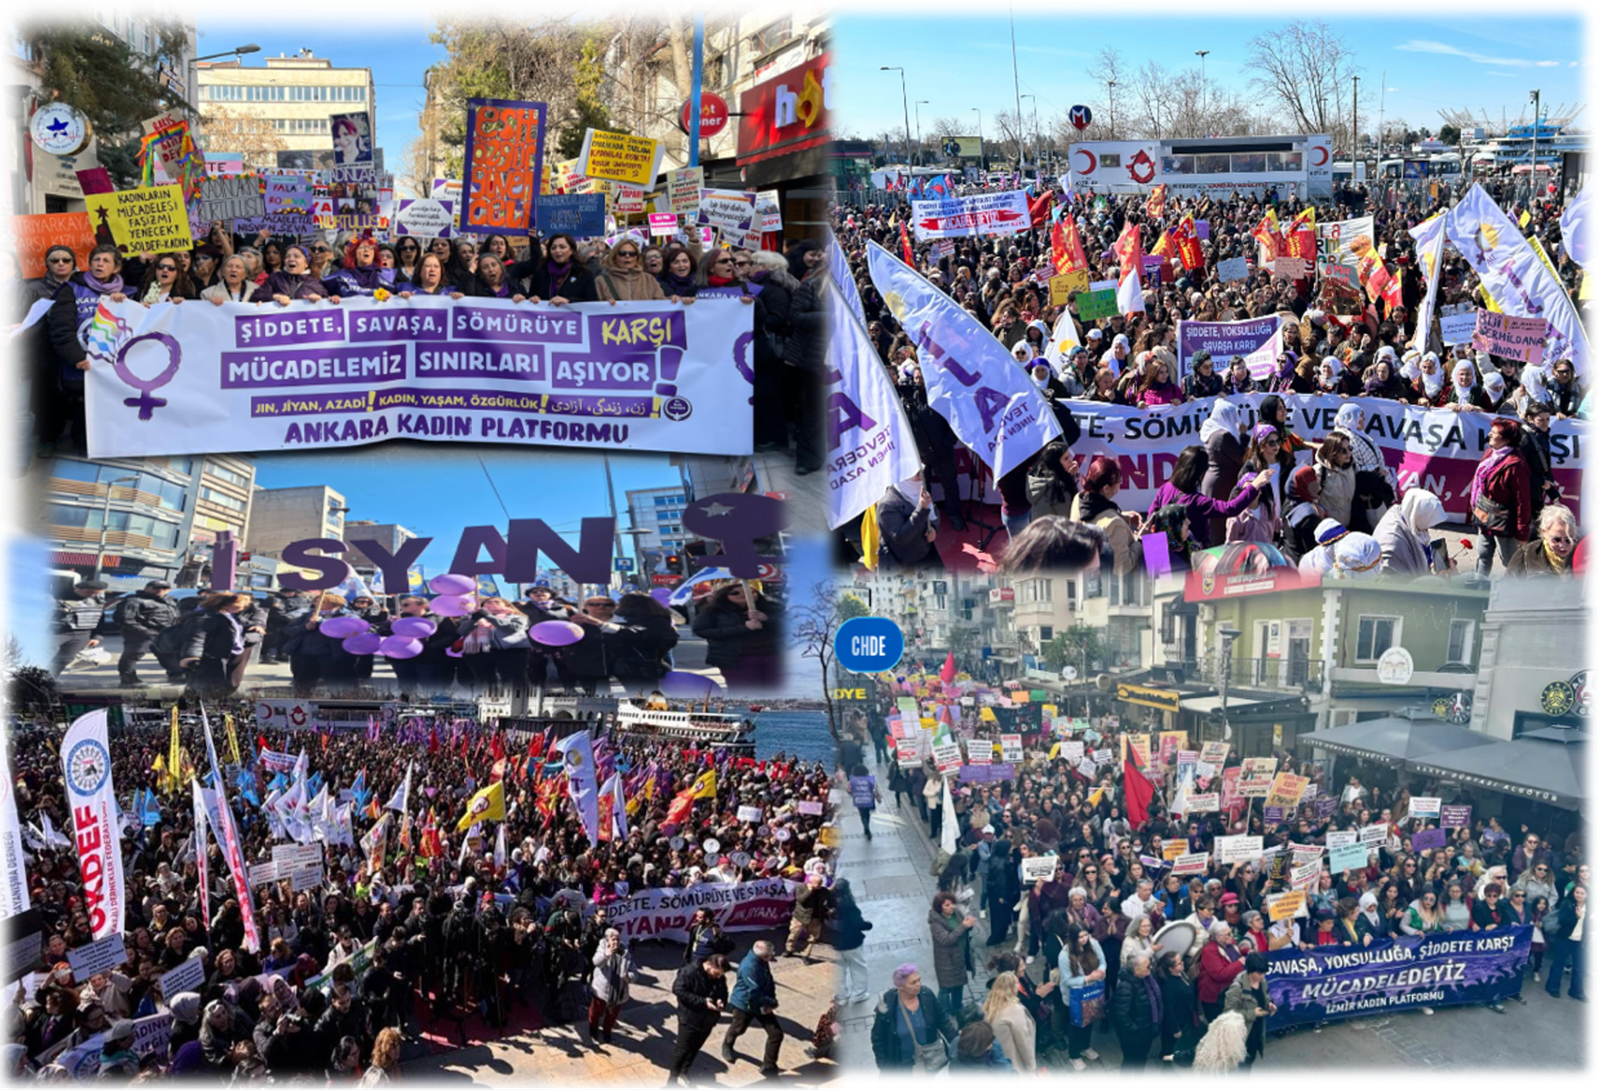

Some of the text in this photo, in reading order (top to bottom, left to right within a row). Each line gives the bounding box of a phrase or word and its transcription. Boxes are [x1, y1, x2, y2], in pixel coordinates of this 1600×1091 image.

[241, 311, 672, 347] ŞİDDETE, SAVAŞA, SÖMÜRÜYE KARŞI
[1186, 321, 1273, 341] ŞİDDETE, YOKSULLUĞA
[1202, 340, 1258, 354] SAVAŞA KARŞI
[228, 350, 402, 382] MÜCADELEMİZ
[419, 351, 539, 374] SINIRLARI
[379, 393, 418, 407] KADIN,
[420, 393, 467, 408] YAŞAM,
[284, 413, 629, 444] ANKARA KADIN PLATFORMU
[1302, 408, 1336, 431] VE
[1266, 935, 1515, 977] SAVAŞA, YOKSULLUĞA, ŞİDDETE KARŞI
[1302, 958, 1466, 999] MÜCADELEDEYİZ
[1325, 990, 1444, 1015] İZMİR KADIN PLATFORMU
